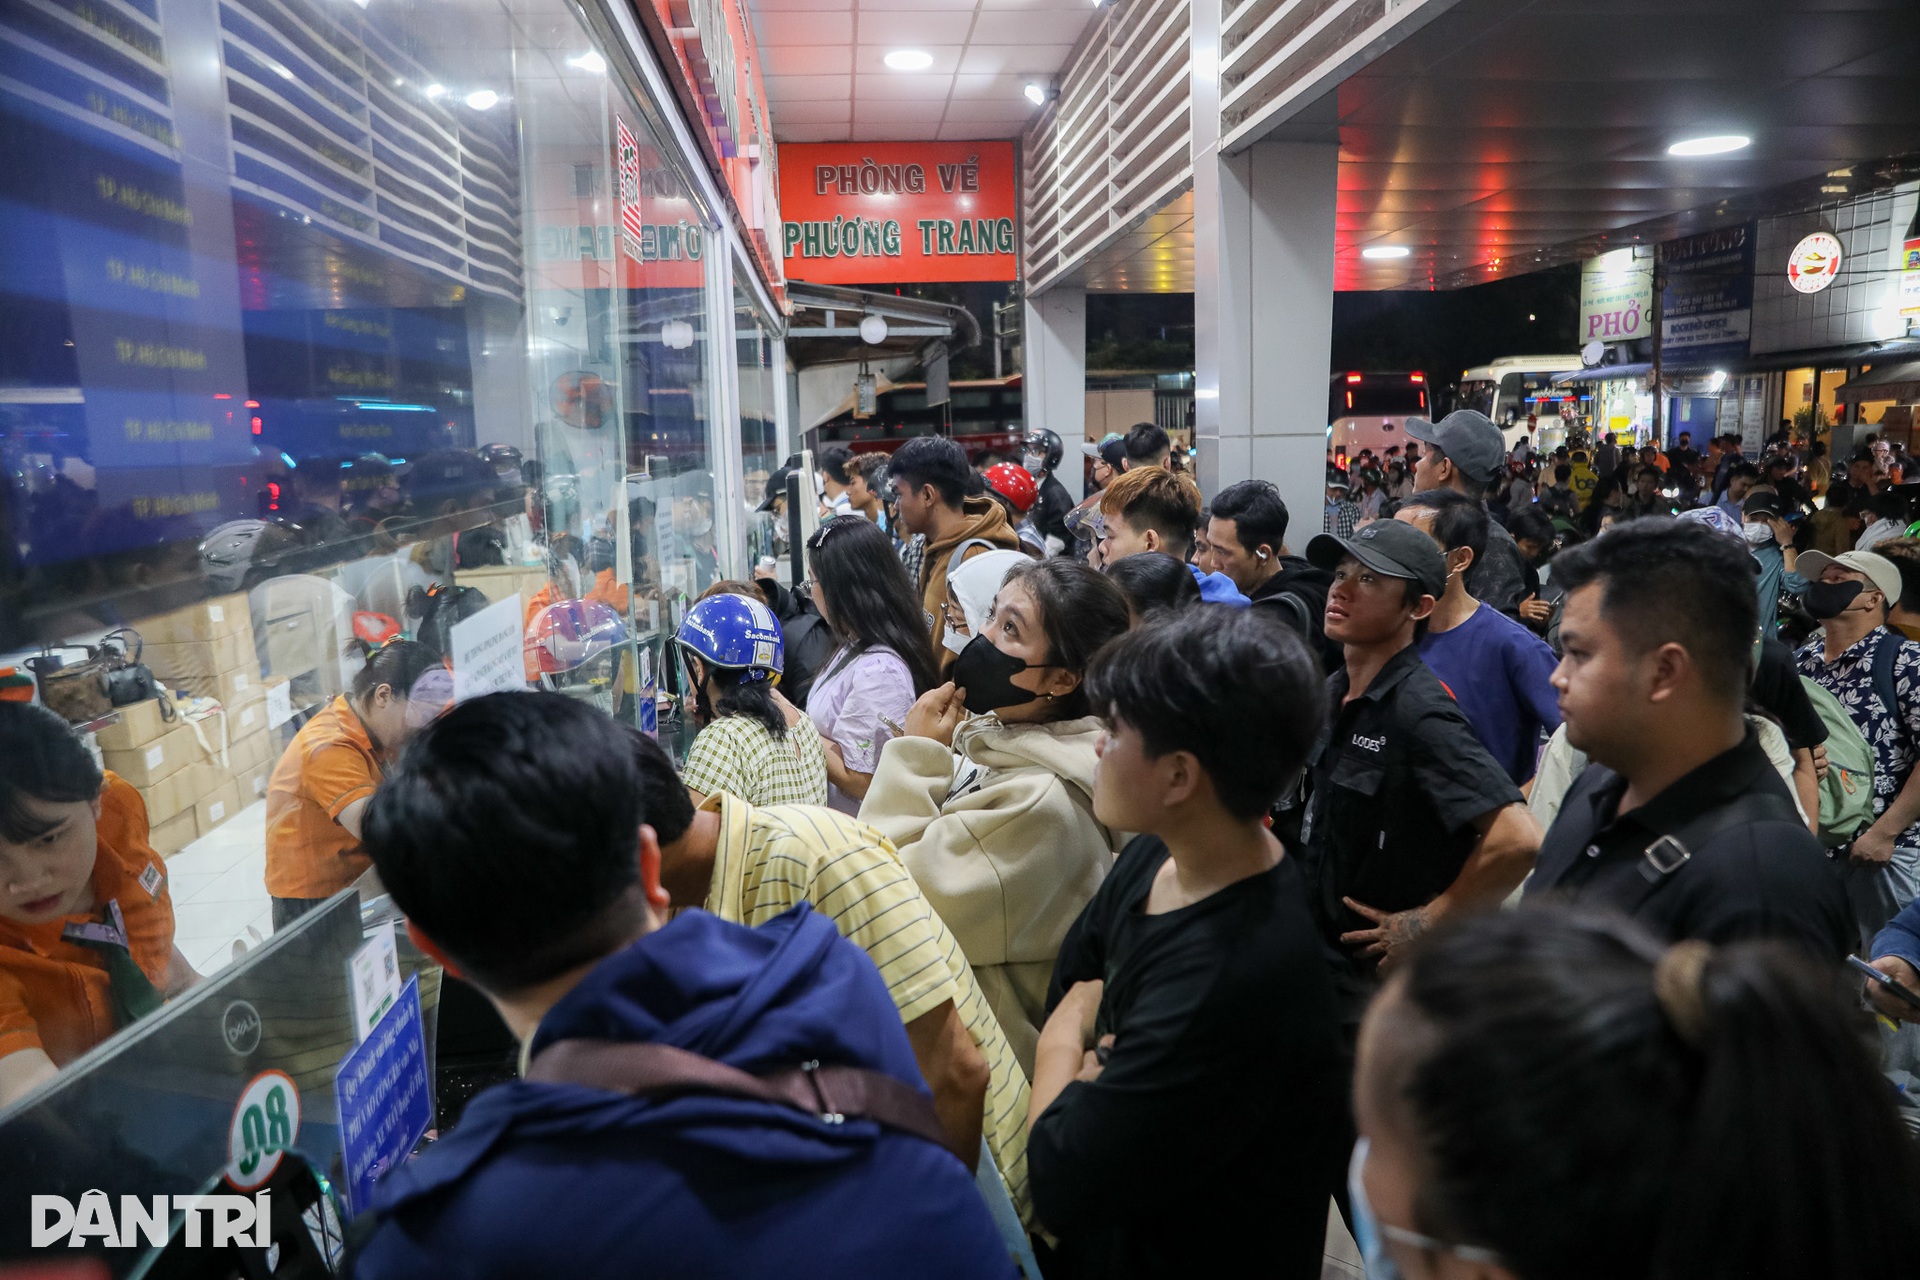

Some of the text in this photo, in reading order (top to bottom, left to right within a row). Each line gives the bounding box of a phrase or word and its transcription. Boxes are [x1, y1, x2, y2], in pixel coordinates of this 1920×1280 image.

[816, 154, 979, 195] PHÒNG VÉ
[783, 215, 1014, 258] PHƯƠNG TRANG
[1588, 299, 1641, 338] PHỞ
[745, 629, 781, 644] Sacombank
[228, 1015, 259, 1043] DELL
